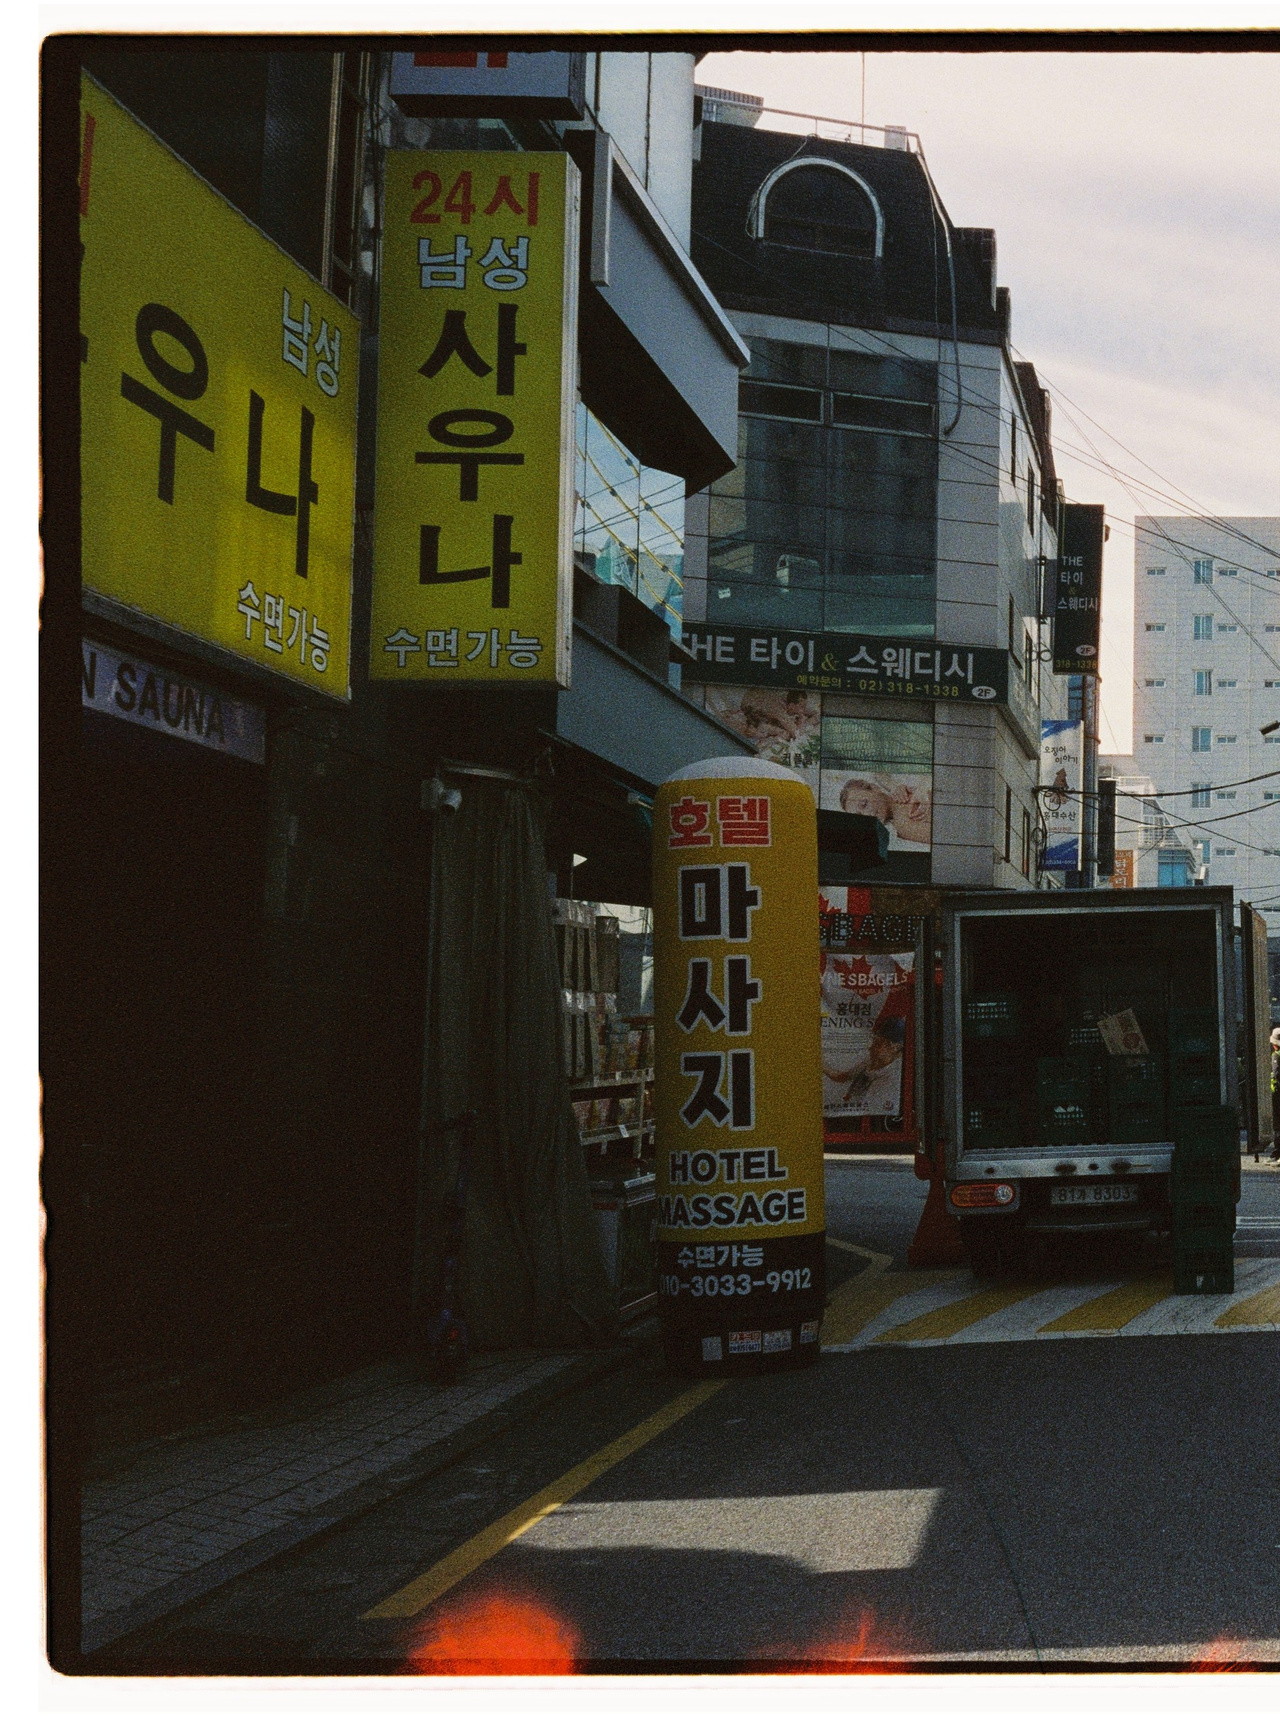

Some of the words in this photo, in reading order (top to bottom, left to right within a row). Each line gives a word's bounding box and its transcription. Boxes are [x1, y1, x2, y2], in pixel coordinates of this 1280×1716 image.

[410, 170, 540, 228] 24시
[417, 234, 531, 292] 남성
[281, 287, 342, 398] 남성
[81, 301, 319, 579] 우나
[414, 301, 528, 609] 사우나
[1060, 571, 1084, 586] 타이
[1061, 555, 1083, 567] THE
[236, 580, 332, 673] 수면가능
[1057, 596, 1099, 611] 스웨디시
[383, 626, 544, 670] 수면가능
[682, 632, 736, 664] HE
[750, 638, 815, 673] 타이
[820, 654, 840, 672] &
[845, 643, 974, 685] 스웨디시
[1079, 646, 1091, 655] 2F
[115, 662, 226, 743] SAUNA
[976, 687, 992, 698] 2F
[667, 796, 773, 849] 호텔
[677, 862, 762, 1132] 마사지
[669, 1146, 789, 1186] HOTEL
[657, 1187, 807, 1230] MASSAGE
[677, 1244, 765, 1270] 수면가능
